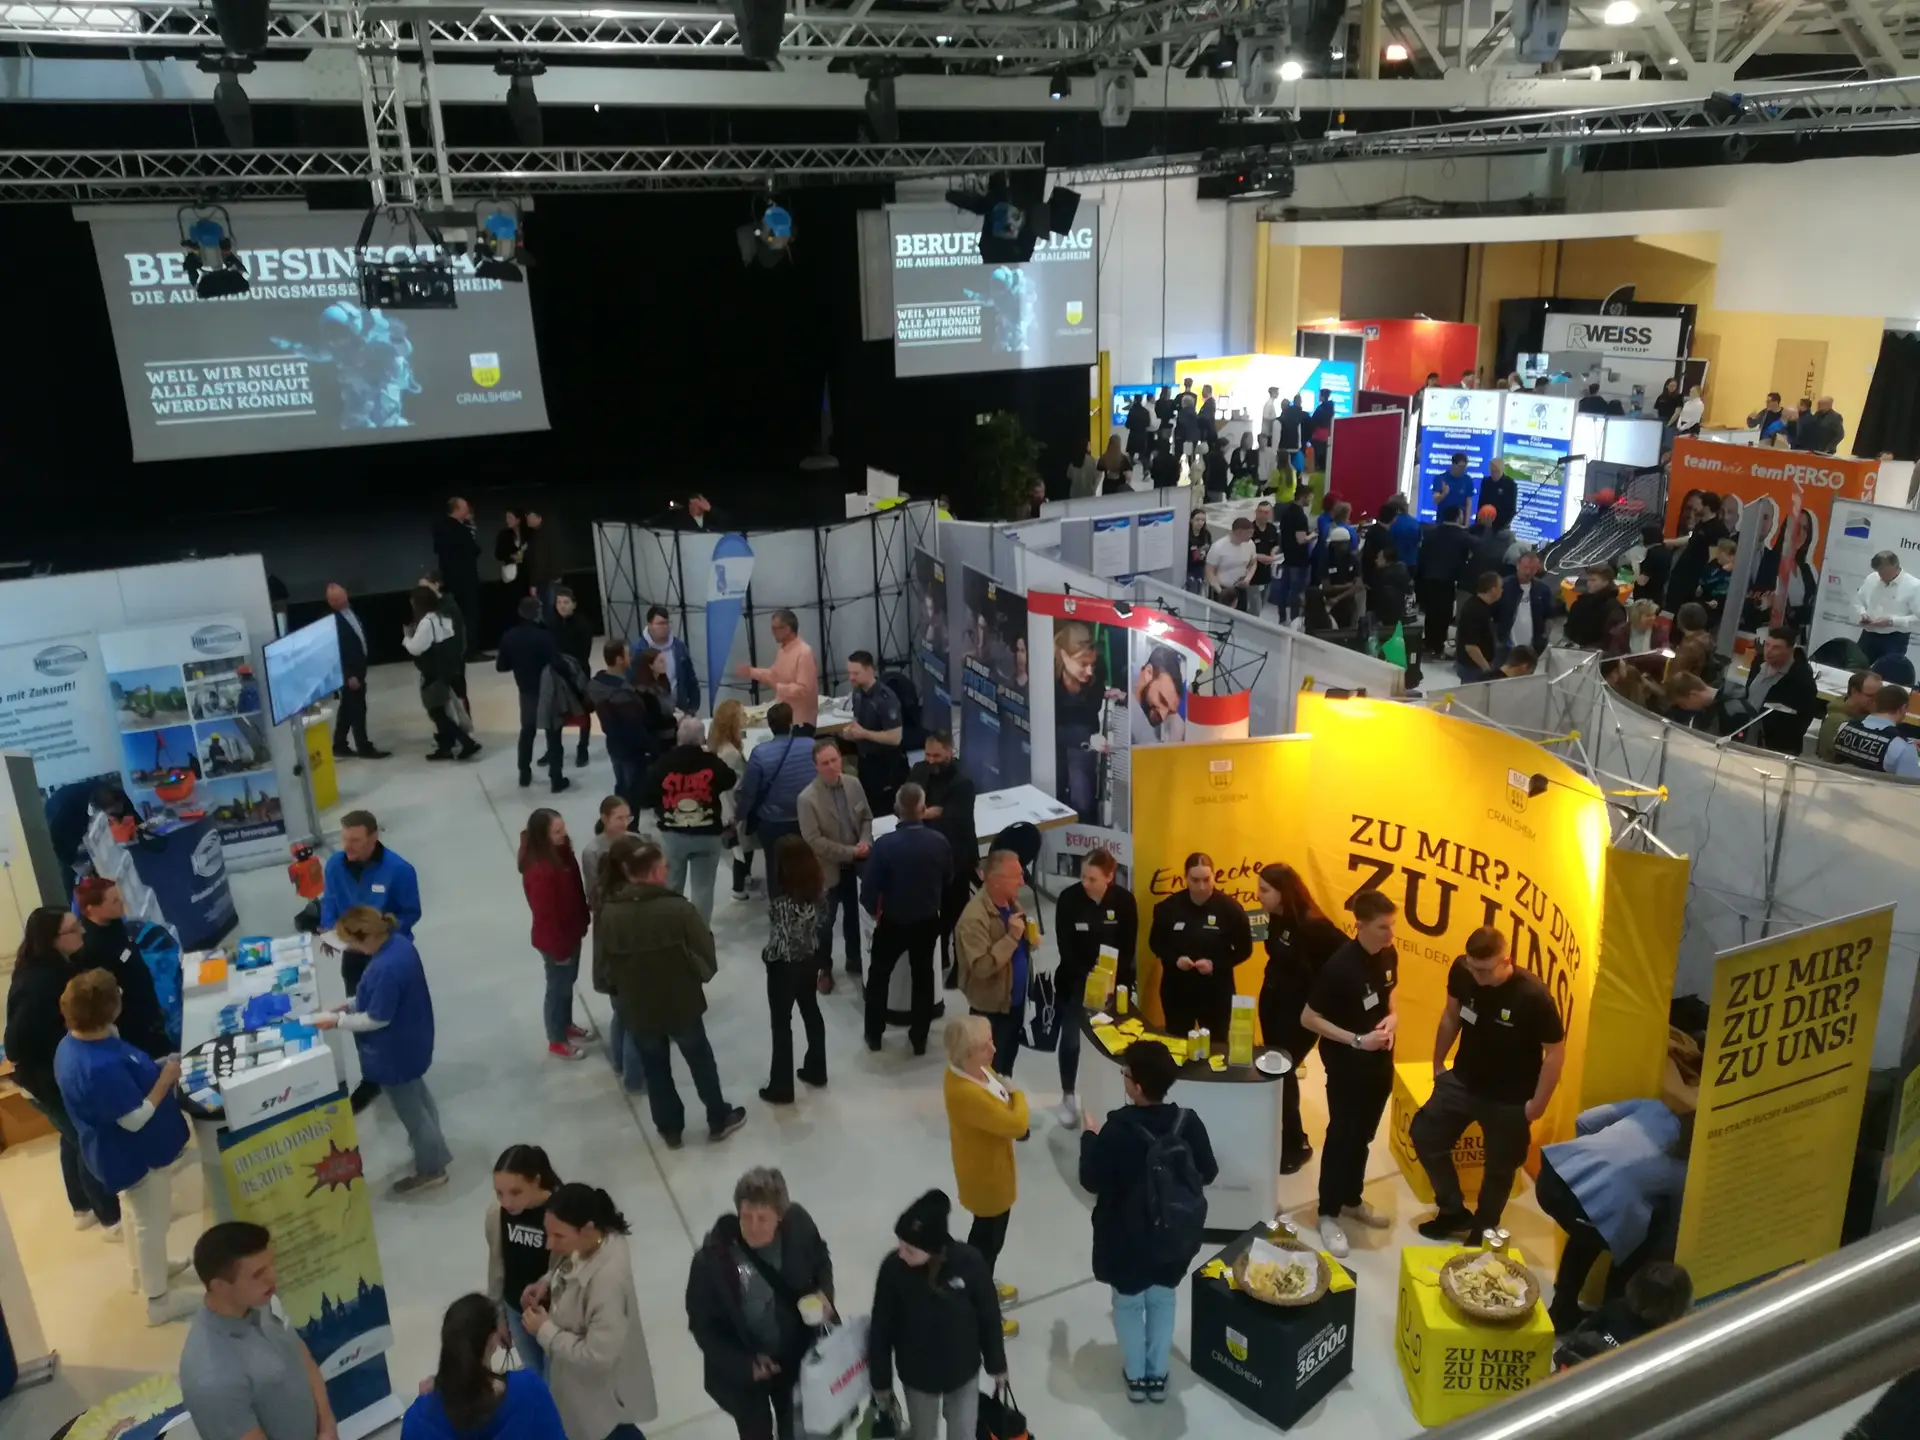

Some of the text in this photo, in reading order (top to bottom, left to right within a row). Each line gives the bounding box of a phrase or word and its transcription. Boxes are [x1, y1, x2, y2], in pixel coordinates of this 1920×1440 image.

[895, 257, 913, 269] DIE
[131, 290, 165, 305] DIE
[897, 305, 981, 320] WEIL WIR NICHT
[897, 315, 981, 330] ALLE ASTRONAUT
[897, 324, 982, 340] WERDEN KÖNNEN
[145, 362, 309, 385] WEIL WIR NICHT
[150, 377, 310, 400] ALLE ASTRONAUT
[456, 389, 522, 405] CRAILSHEIM
[151, 391, 314, 415] WERDEN KÖNNEN
[1683, 454, 1722, 471] team
[6, 680, 77, 704] mit Zukunft!
[1837, 730, 1884, 756] POLIZEI
[1486, 807, 1538, 843] CRAILSHEIM
[1343, 852, 1461, 939] ZU
[1348, 813, 1581, 981] ZU MIR? ZU DIR?
[1395, 934, 1452, 967] TEIL DER
[1725, 935, 1875, 1012] ZU MIR?
[1719, 976, 1861, 1050] ZU DIR?
[1713, 1011, 1859, 1088] ZU UNS!
[507, 1223, 545, 1248] VANS
[1295, 1324, 1348, 1382] 36.000
[1444, 1347, 1537, 1364] ZU MIR?
[1210, 1349, 1264, 1389] CRAILSHEIM
[1443, 1361, 1531, 1378] ZU DIR?
[1442, 1375, 1532, 1392] ZU UNS!
